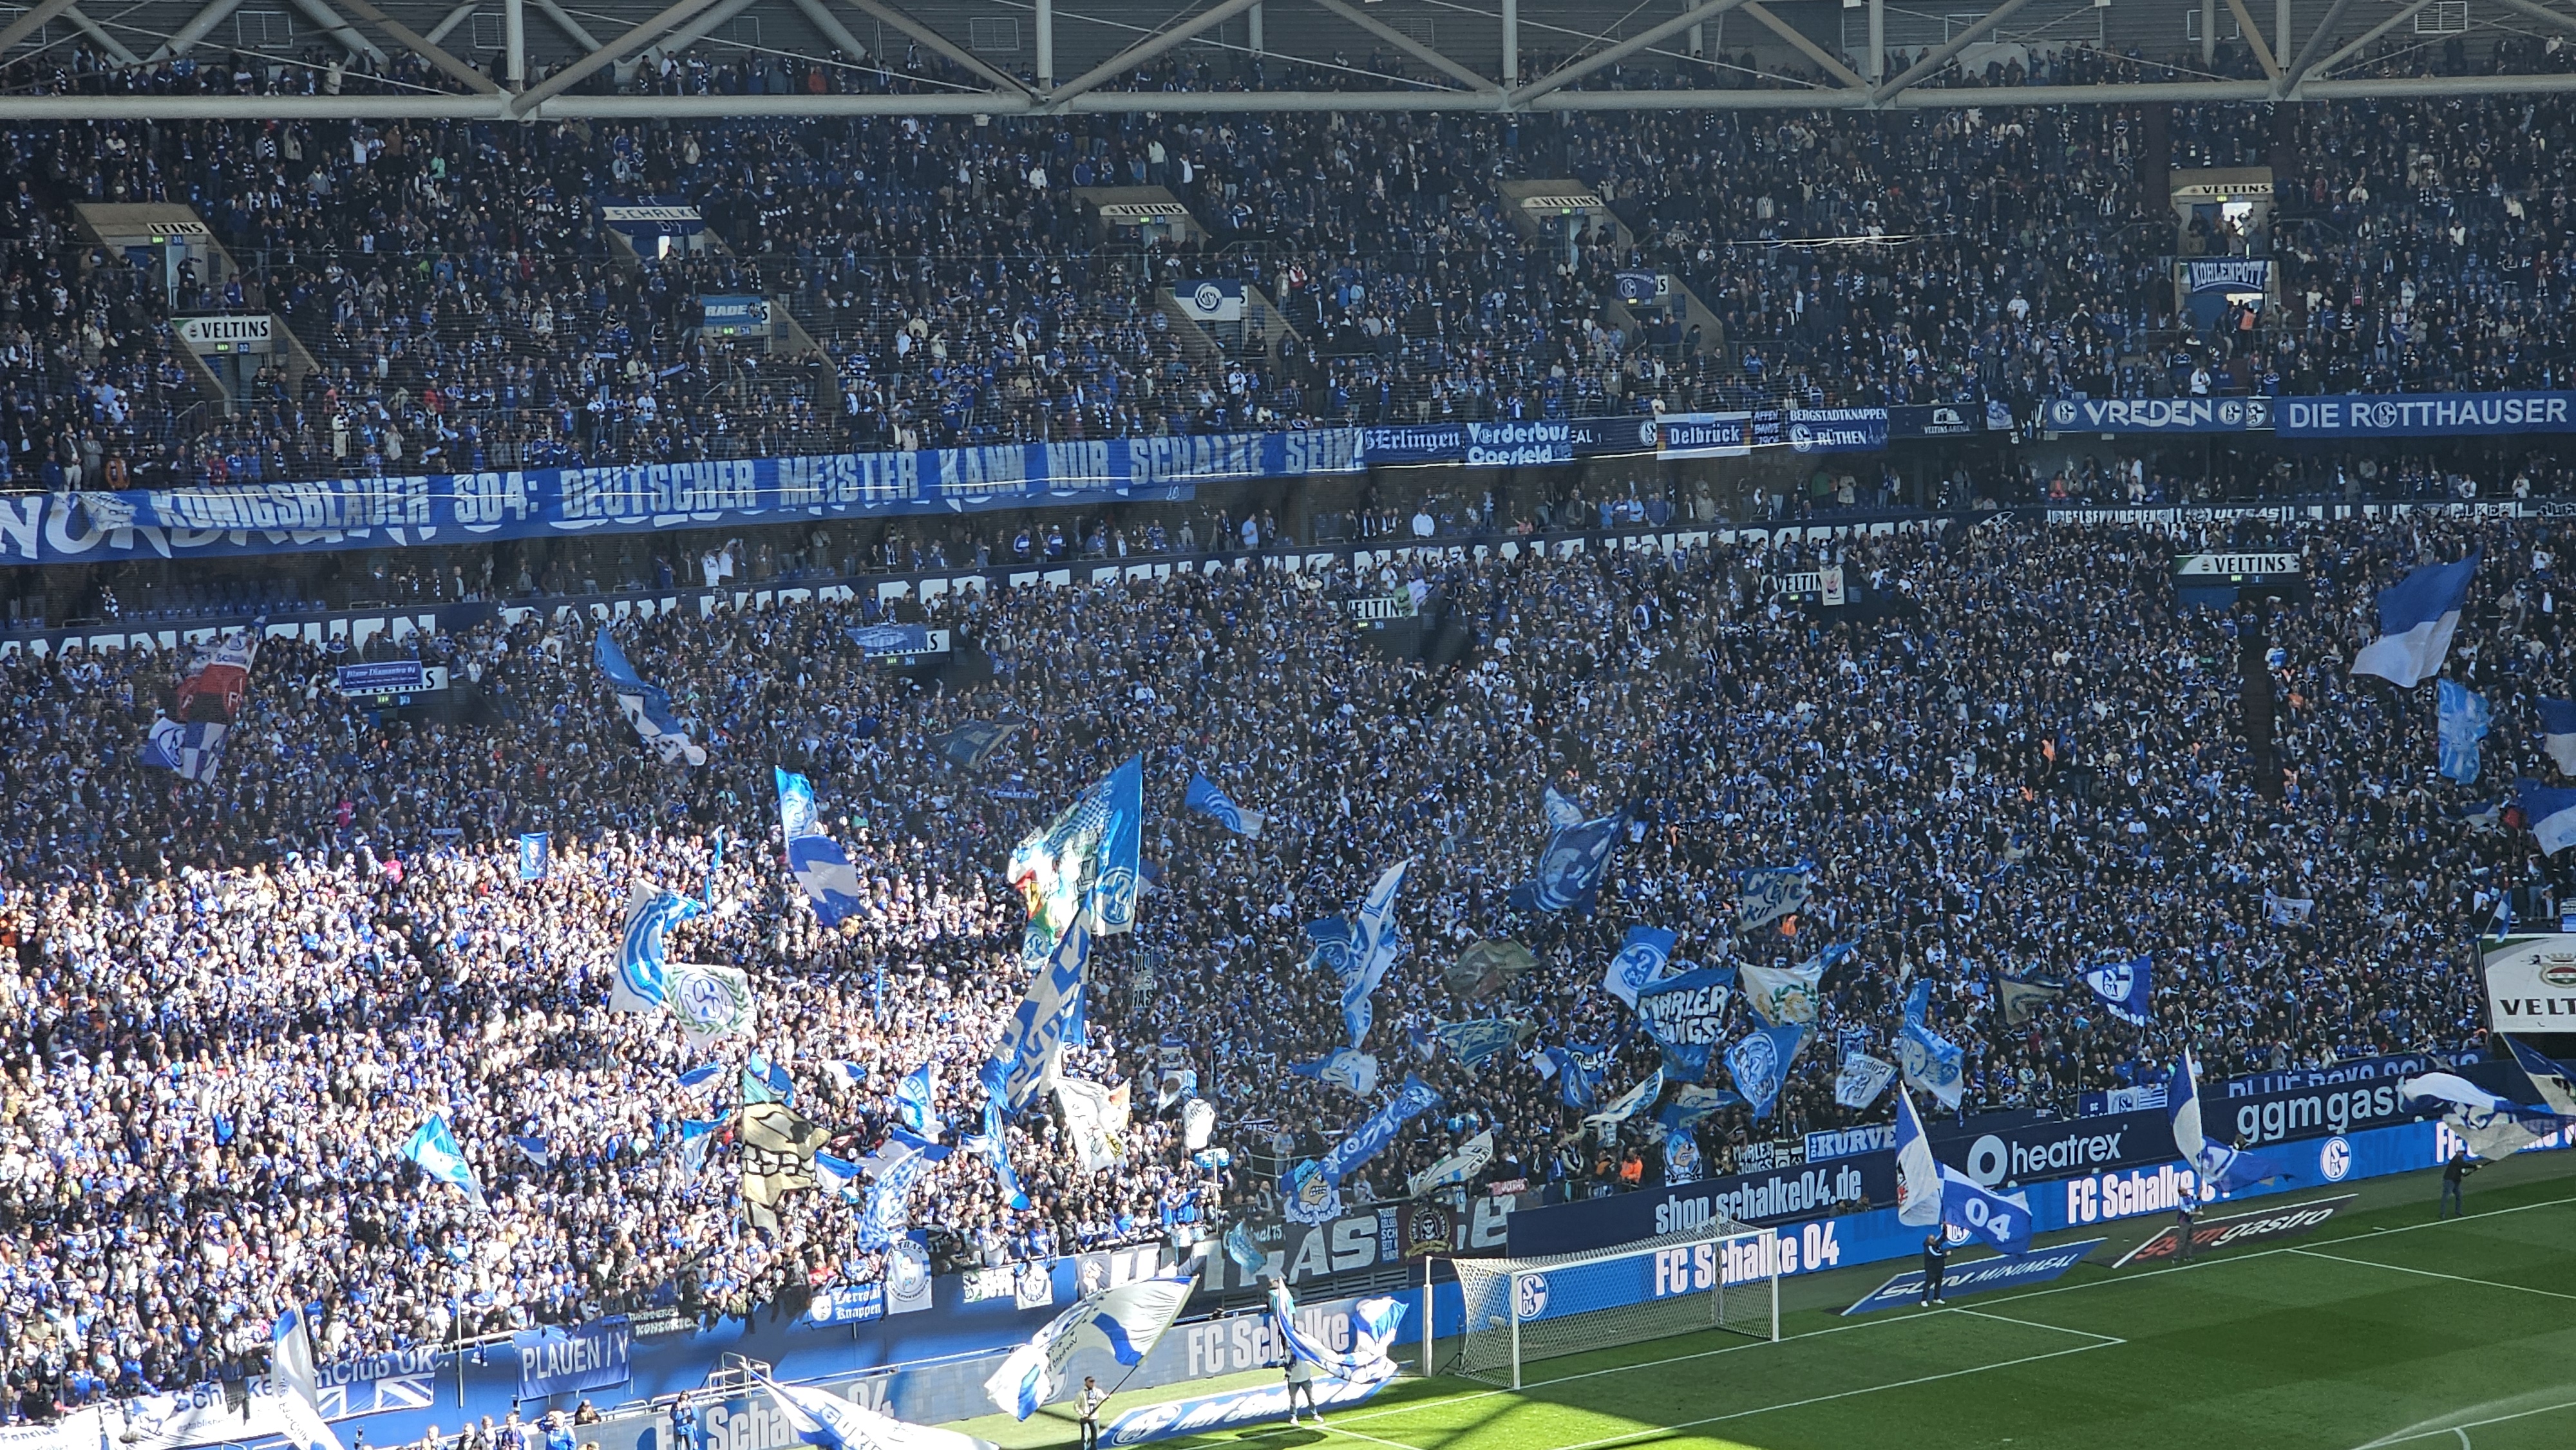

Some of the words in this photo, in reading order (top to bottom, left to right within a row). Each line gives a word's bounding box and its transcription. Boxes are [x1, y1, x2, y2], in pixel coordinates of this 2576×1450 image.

[1544, 196, 1600, 207] VELTINS
[2202, 184, 2269, 194] VELTINS
[1118, 203, 1183, 215] VELTINS
[2191, 260, 2264, 287] KOHLENPOTT
[201, 321, 269, 338] VELTINS
[1790, 408, 1888, 422] BERGSTADTKNAPPEN
[2083, 399, 2212, 426] VREDEN
[2290, 402, 2340, 429] DIE
[1670, 424, 1740, 445] Delbrück
[1817, 428, 1867, 446] RÜTHEN
[1924, 426, 1948, 435] VELTINS
[1468, 446, 1553, 464] Coesfeld
[560, 459, 757, 518] DEUTSCHER
[778, 451, 920, 505] MEISTER
[938, 445, 1027, 497] KANN
[1046, 439, 1110, 489] NUR
[2214, 556, 2286, 573] VELTINS
[1638, 985, 1728, 1022] MARLER
[1817, 1125, 1897, 1157] KURVE
[2012, 1131, 2123, 1174] heatrex
[1655, 1164, 1862, 1235] shop.schalke04.de
[2068, 1177, 2097, 1224] FC
[2103, 1164, 2195, 1218] Schalke
[1964, 1198, 2012, 1243] 04
[1655, 1248, 1688, 1297] FC
[1694, 1232, 1797, 1290] Schalke
[1803, 1221, 1840, 1270] 04
[1970, 1253, 2079, 1283] MINIMEAL
[835, 1303, 882, 1321] Knappen
[521, 1335, 601, 1382] PLAUEN
[1188, 1323, 1225, 1377] FC
[171, 1375, 272, 1413] Schke
[398, 1346, 434, 1374] UK
[706, 1398, 805, 1450] Scha
